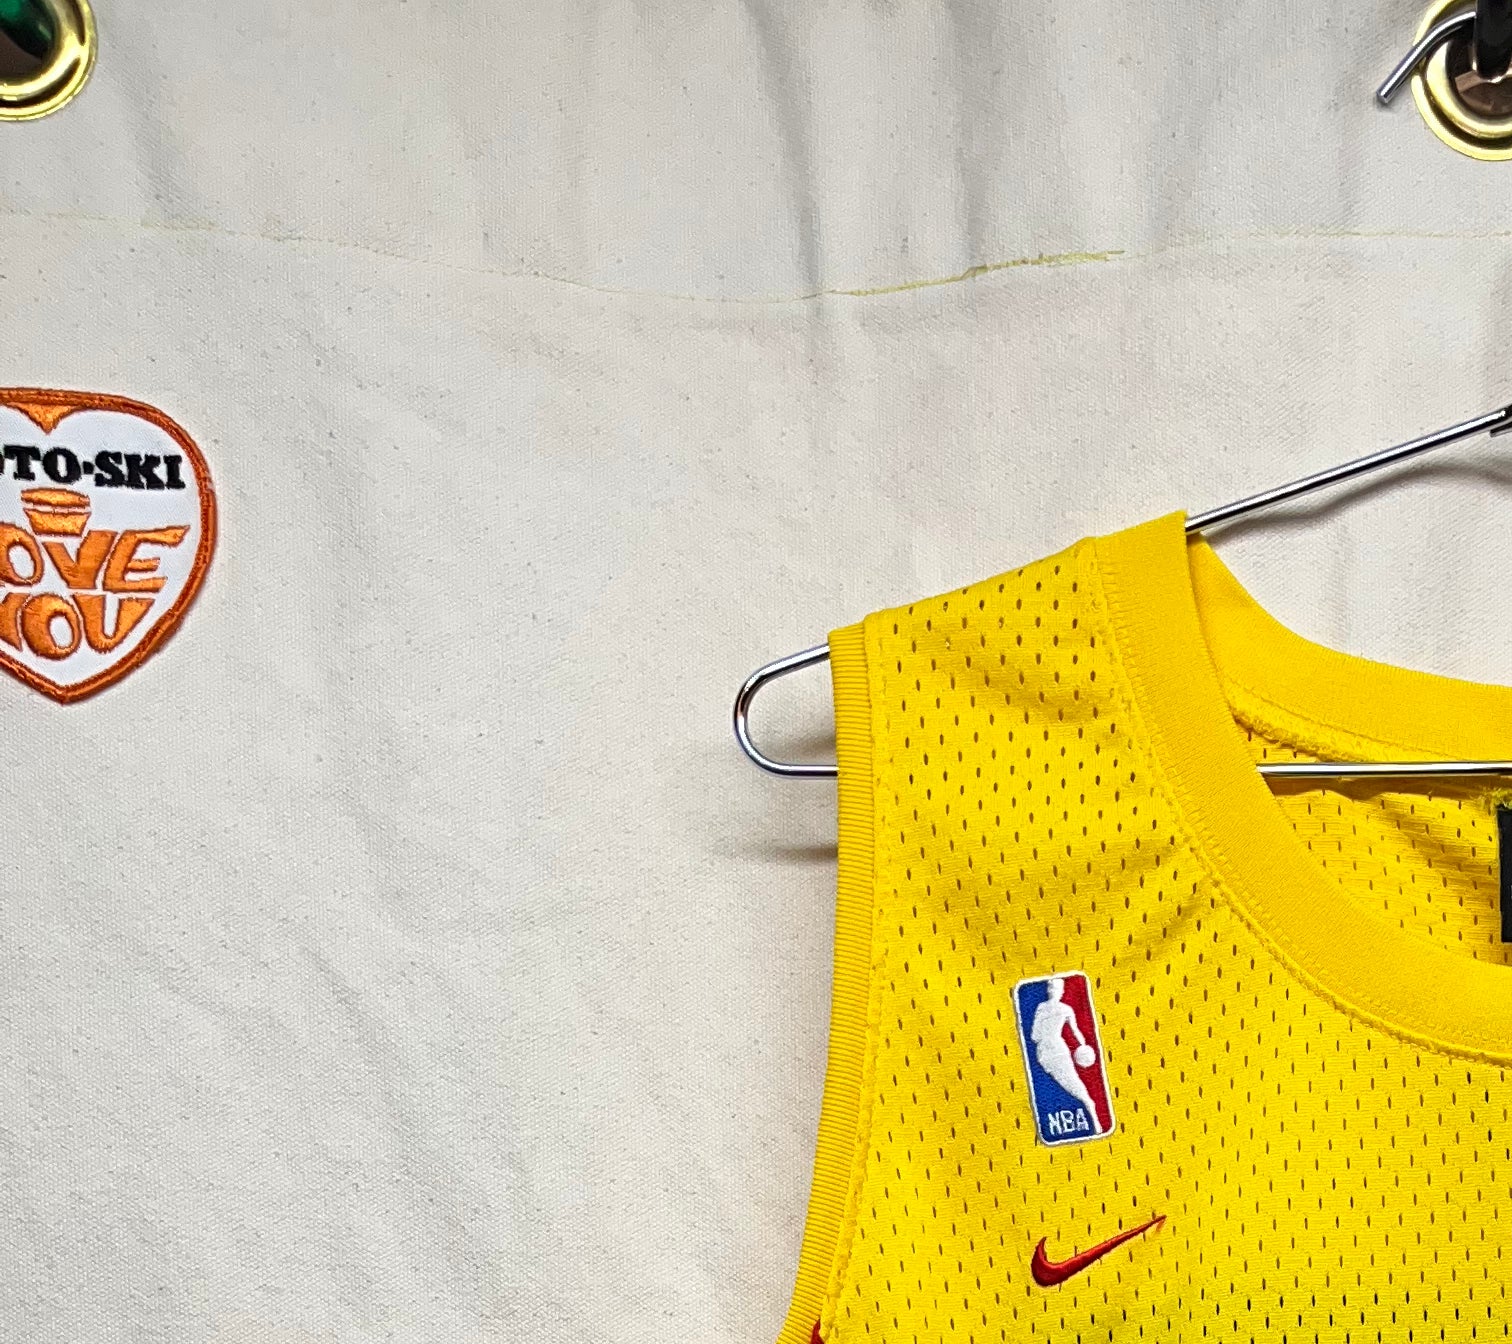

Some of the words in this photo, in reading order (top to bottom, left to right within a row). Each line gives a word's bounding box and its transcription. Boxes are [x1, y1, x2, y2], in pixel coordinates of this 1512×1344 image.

[0, 444, 186, 490] TO-SKI
[0, 523, 190, 593] OVE
[1047, 1108, 1090, 1136] NBA
